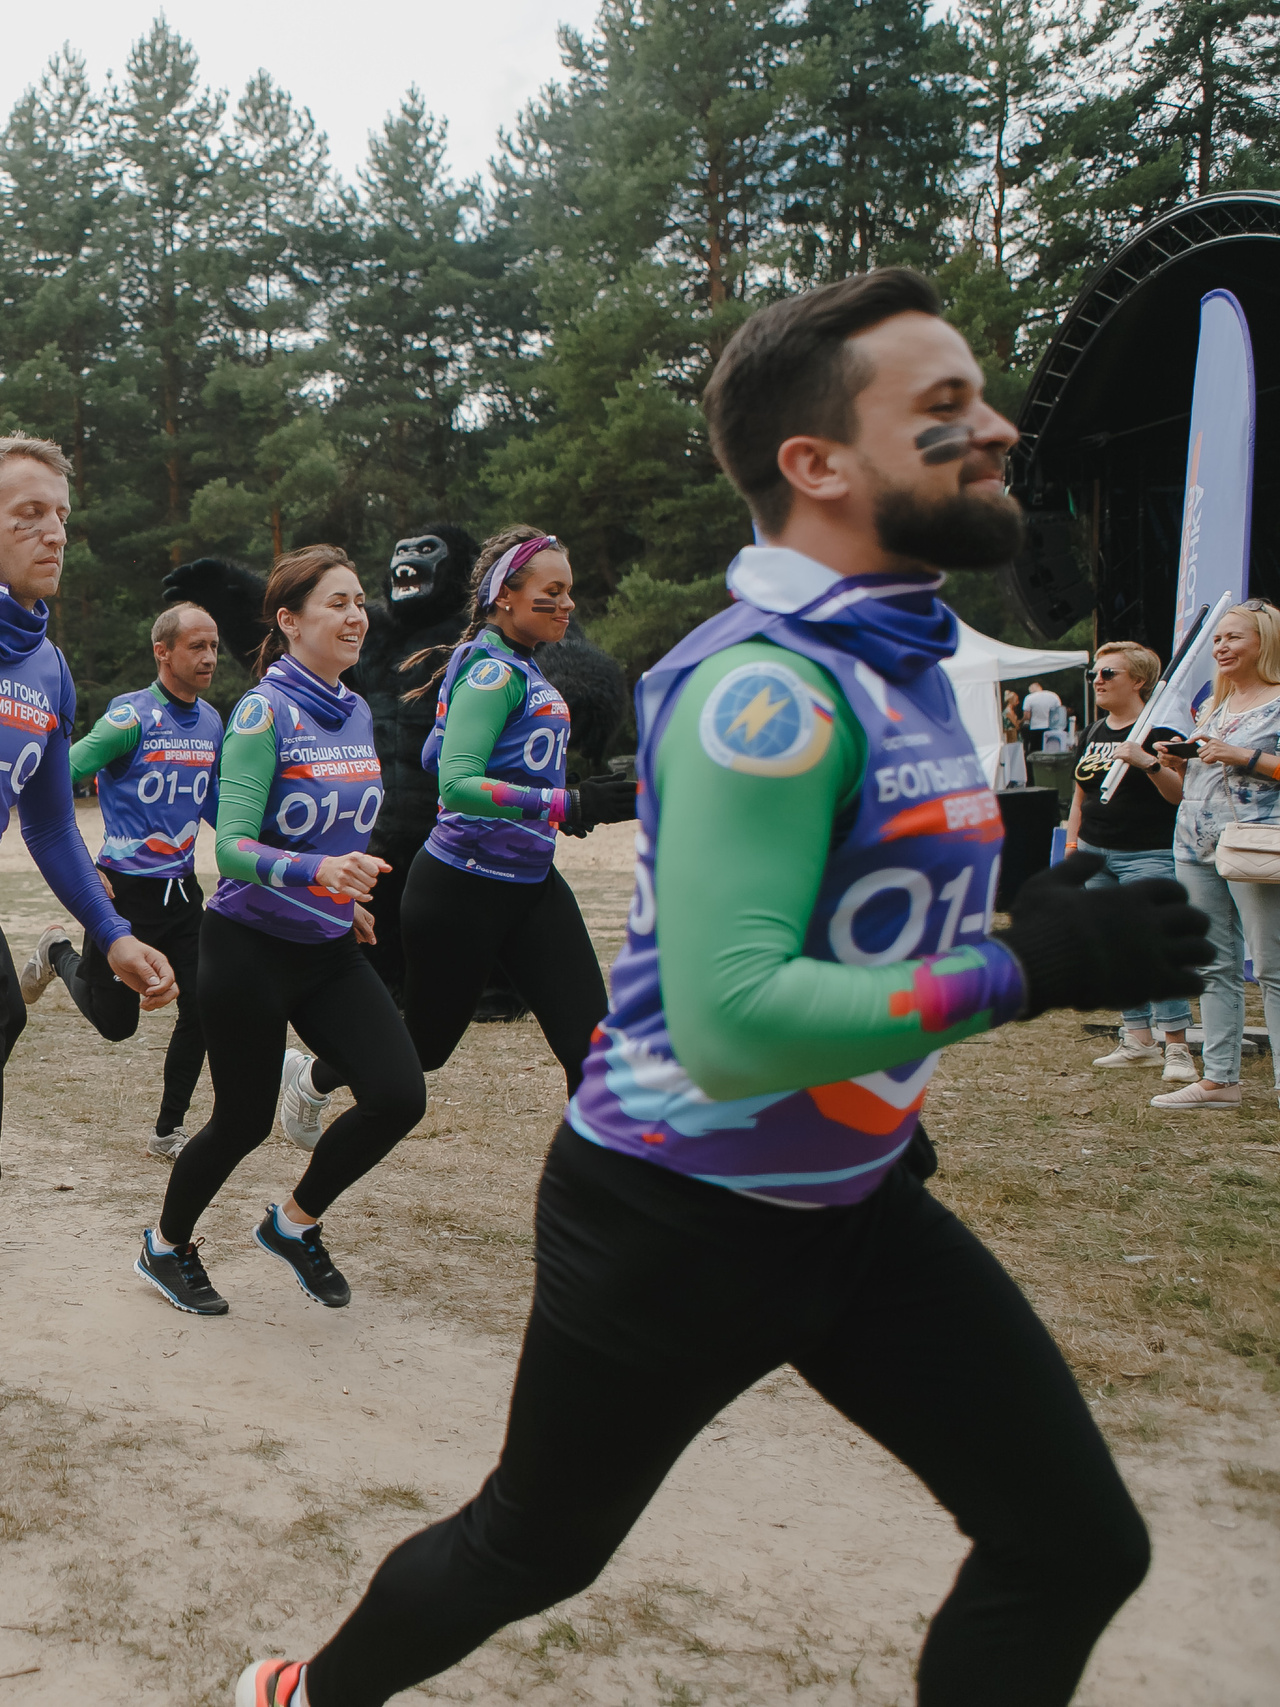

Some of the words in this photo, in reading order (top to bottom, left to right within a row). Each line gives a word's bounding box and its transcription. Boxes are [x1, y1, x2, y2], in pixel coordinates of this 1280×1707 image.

[13, 682, 51, 712] ГОНКА
[13, 703, 50, 729] ГЕРОЕВ
[143, 739, 190, 750] БОЛЬШАЯ
[190, 739, 214, 751] ГОНКА
[165, 751, 191, 761] ВРЕМЯ
[280, 746, 343, 763] БОЛЬШАЯ
[341, 745, 374, 759] ГОНКА
[311, 761, 350, 777] ВРЕМЯ
[137, 770, 210, 805] 01-0
[276, 786, 385, 837] 01-0
